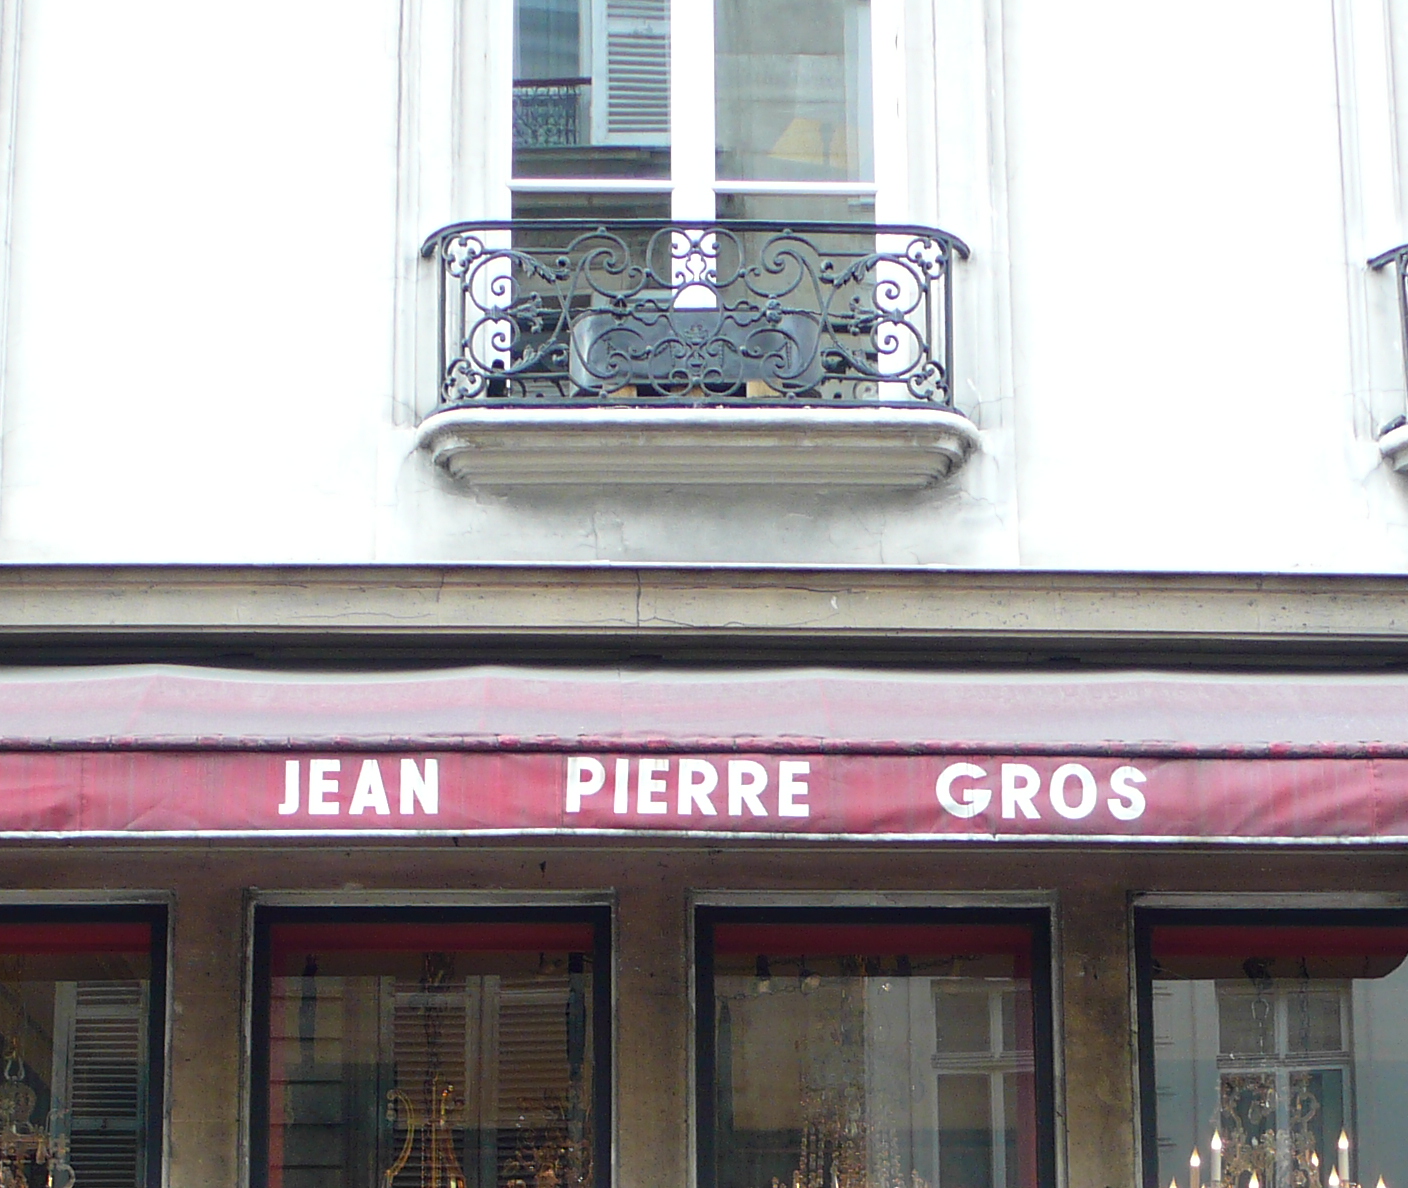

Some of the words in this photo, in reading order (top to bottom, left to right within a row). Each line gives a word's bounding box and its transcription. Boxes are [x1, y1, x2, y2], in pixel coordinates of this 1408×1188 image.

[278, 758, 439, 816] JEAN
[566, 756, 810, 817] PIERRE
[935, 762, 1148, 821] GROS
